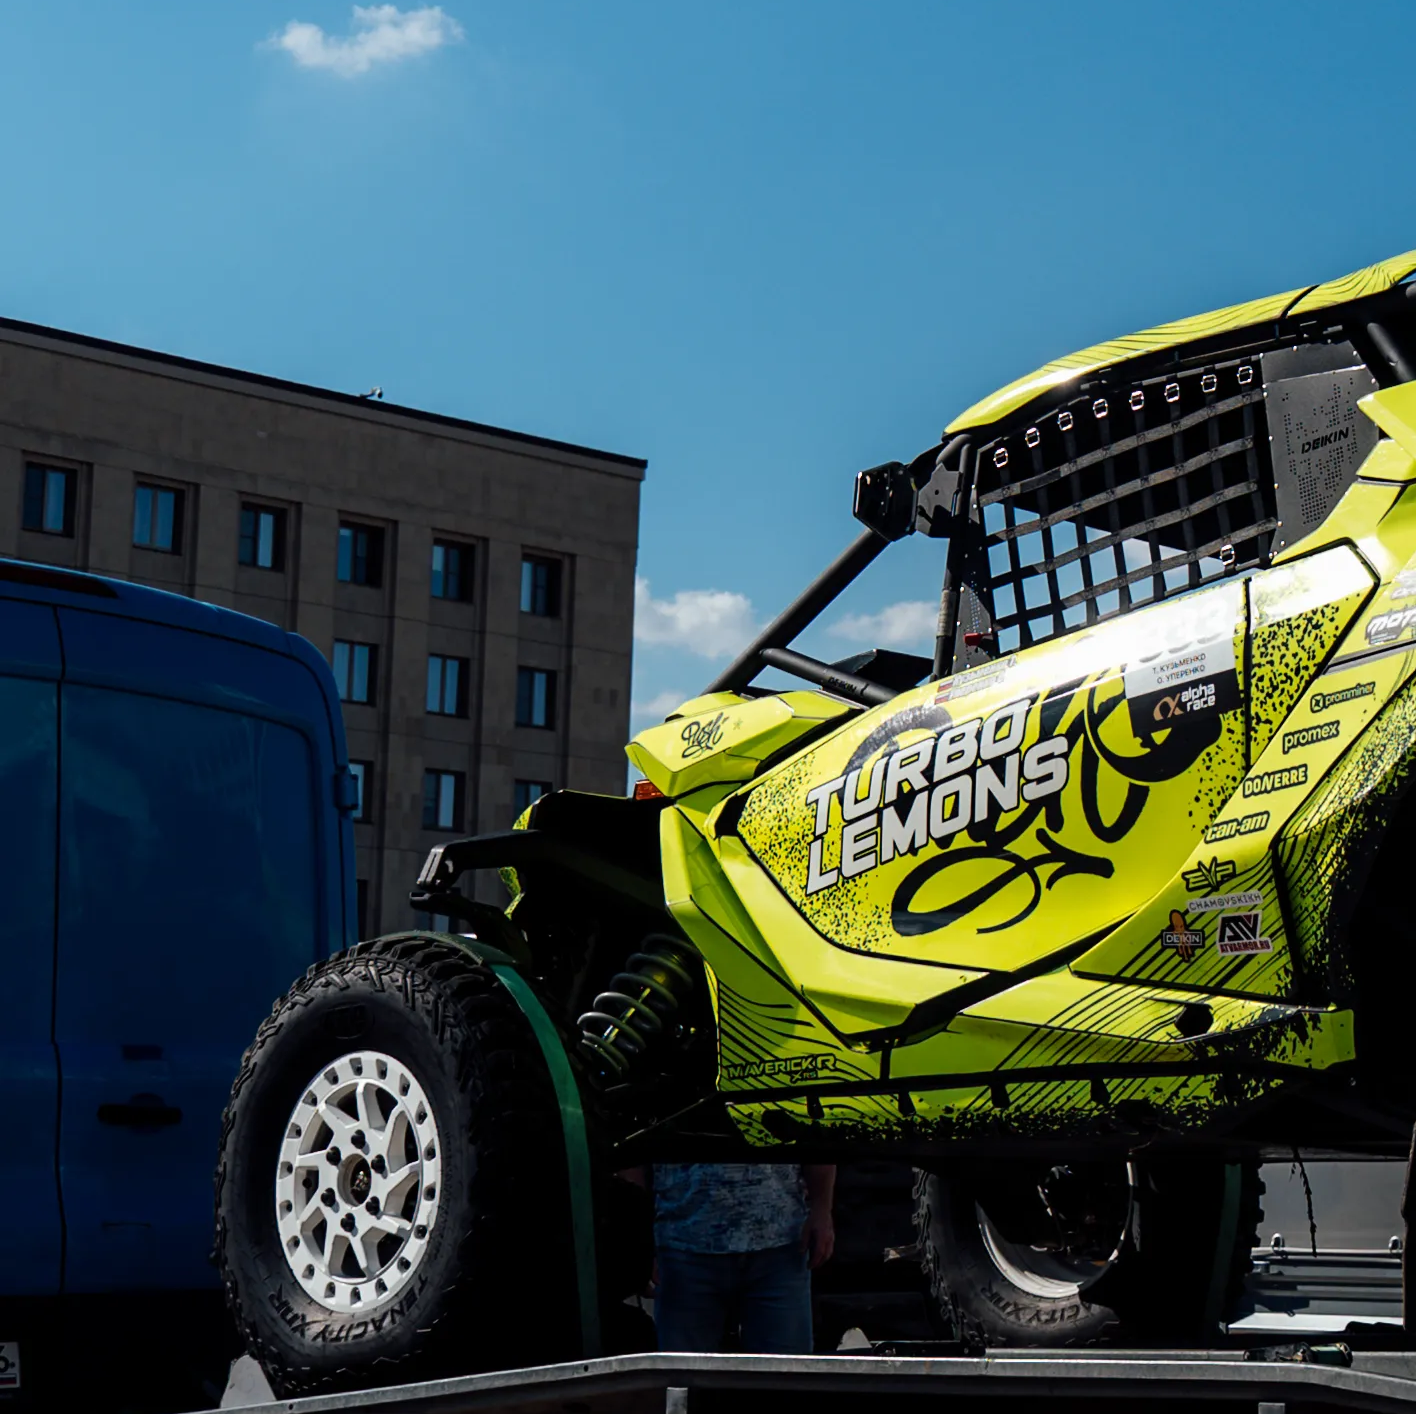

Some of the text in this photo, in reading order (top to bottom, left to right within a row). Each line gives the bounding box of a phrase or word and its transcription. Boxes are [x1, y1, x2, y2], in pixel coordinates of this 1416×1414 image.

[1301, 427, 1350, 454] DEIKIN
[1181, 683, 1216, 704] alpha
[1186, 696, 1216, 712] race
[1284, 722, 1340, 753] promex
[806, 699, 1031, 837] TURBO
[806, 735, 1069, 896] LEMONS
[1205, 813, 1269, 842] can-am
[728, 1055, 814, 1078] MAVERICK
